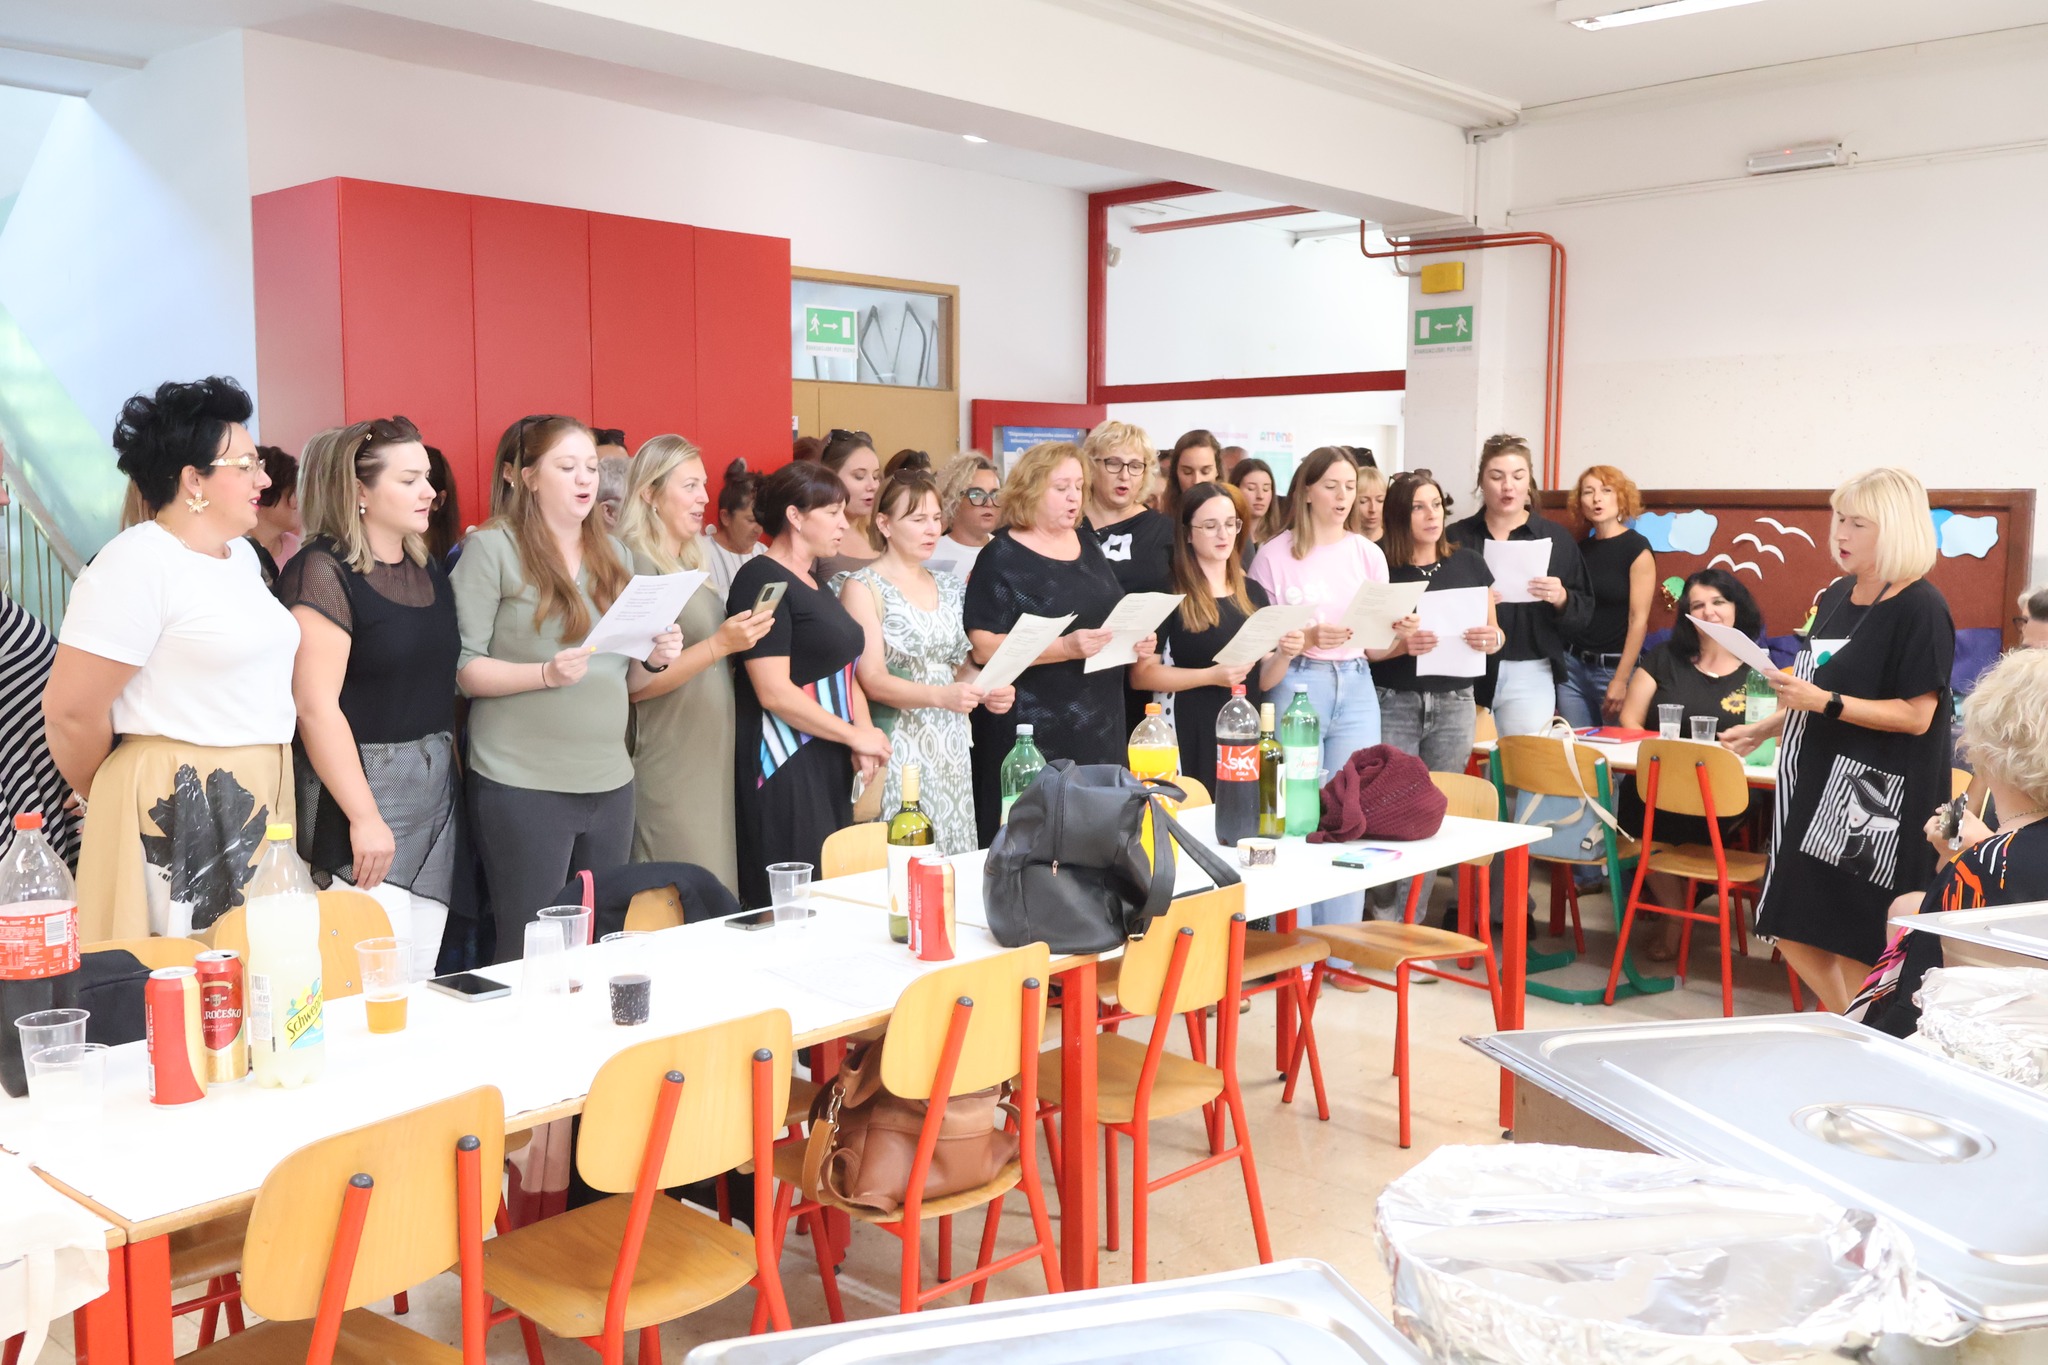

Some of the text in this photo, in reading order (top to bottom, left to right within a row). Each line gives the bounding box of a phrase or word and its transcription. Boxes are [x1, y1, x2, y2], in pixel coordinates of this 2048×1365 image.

[1228, 756, 1255, 770] SKY
[29, 917, 36, 925] 2
[204, 1008, 242, 1020] ROČEŠKO
